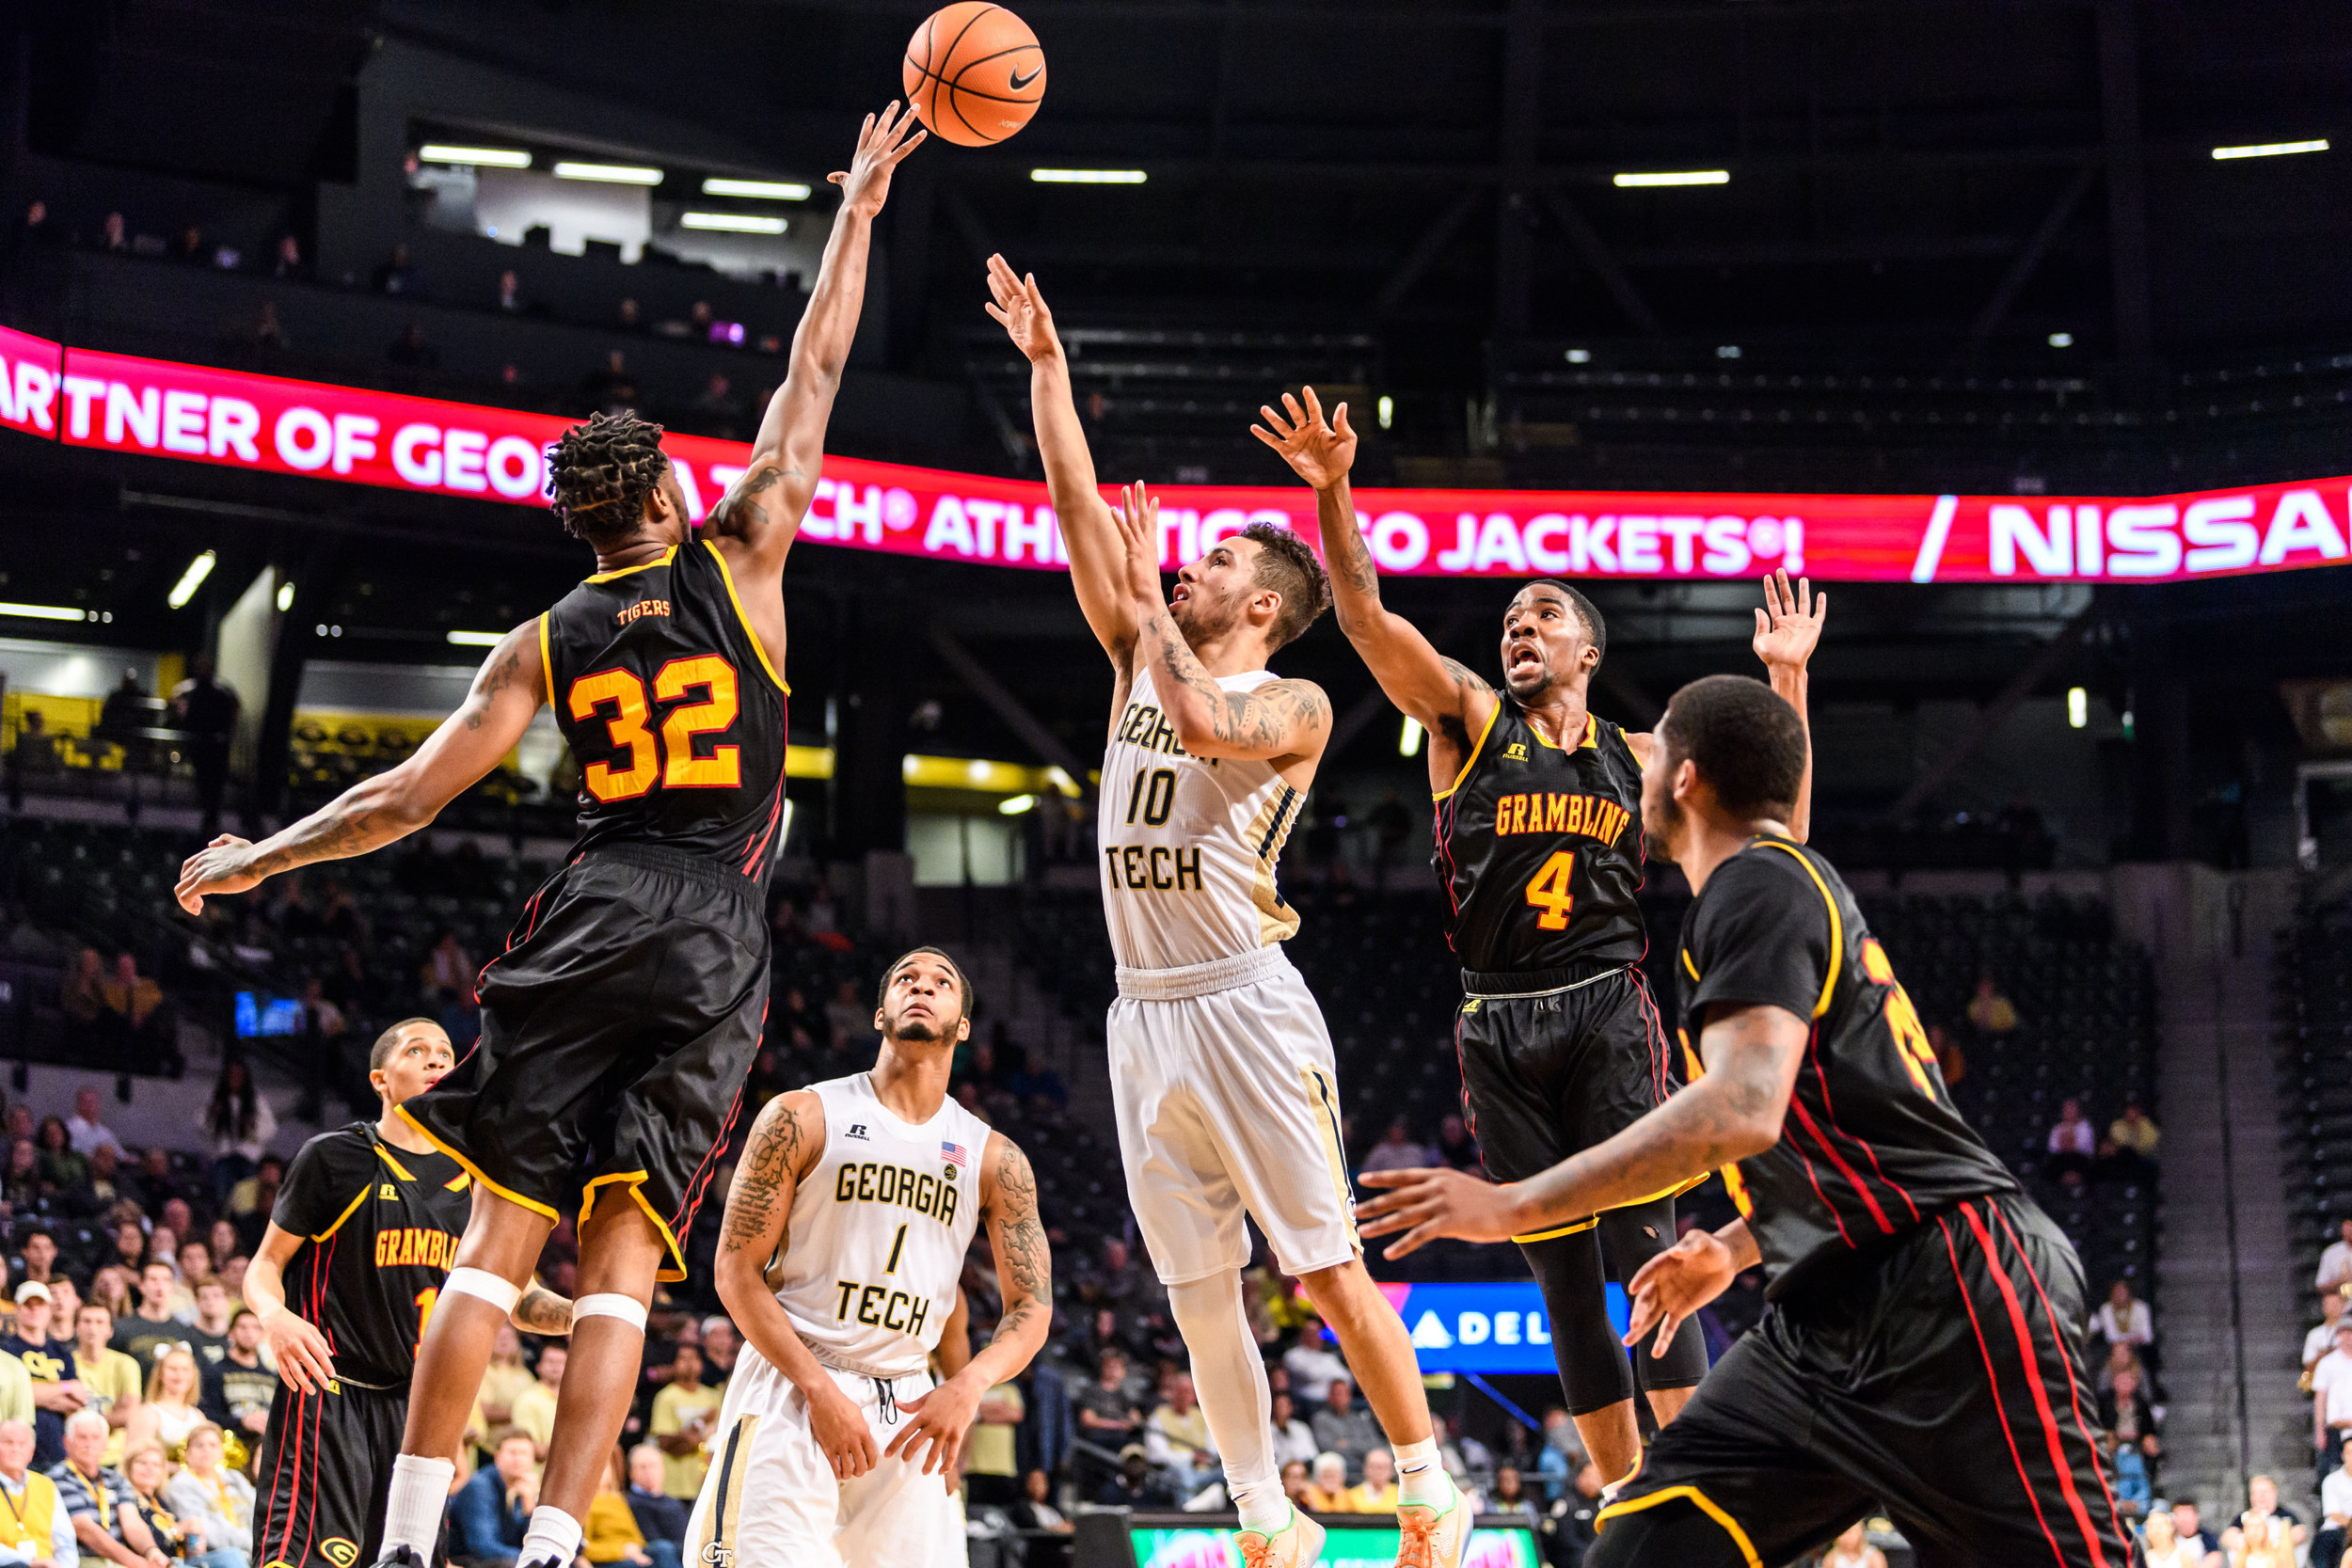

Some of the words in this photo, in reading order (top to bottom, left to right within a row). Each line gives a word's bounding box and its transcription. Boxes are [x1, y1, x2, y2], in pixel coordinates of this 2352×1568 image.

[0, 355, 261, 462] ARTNER
[275, 405, 380, 474] OF
[1989, 488, 2352, 577] NISSA
[617, 599, 671, 626] TIGERS
[567, 653, 742, 804] 32
[1125, 766, 1176, 829] 10
[1105, 845, 1203, 891] TECH
[1525, 849, 1575, 931] 4
[835, 1162, 958, 1227] GEORGIA
[374, 1227, 461, 1274] GRAMBLI
[882, 1223, 908, 1275] 1
[837, 1280, 930, 1338] TECH
[1458, 1311, 1552, 1345] DEL
